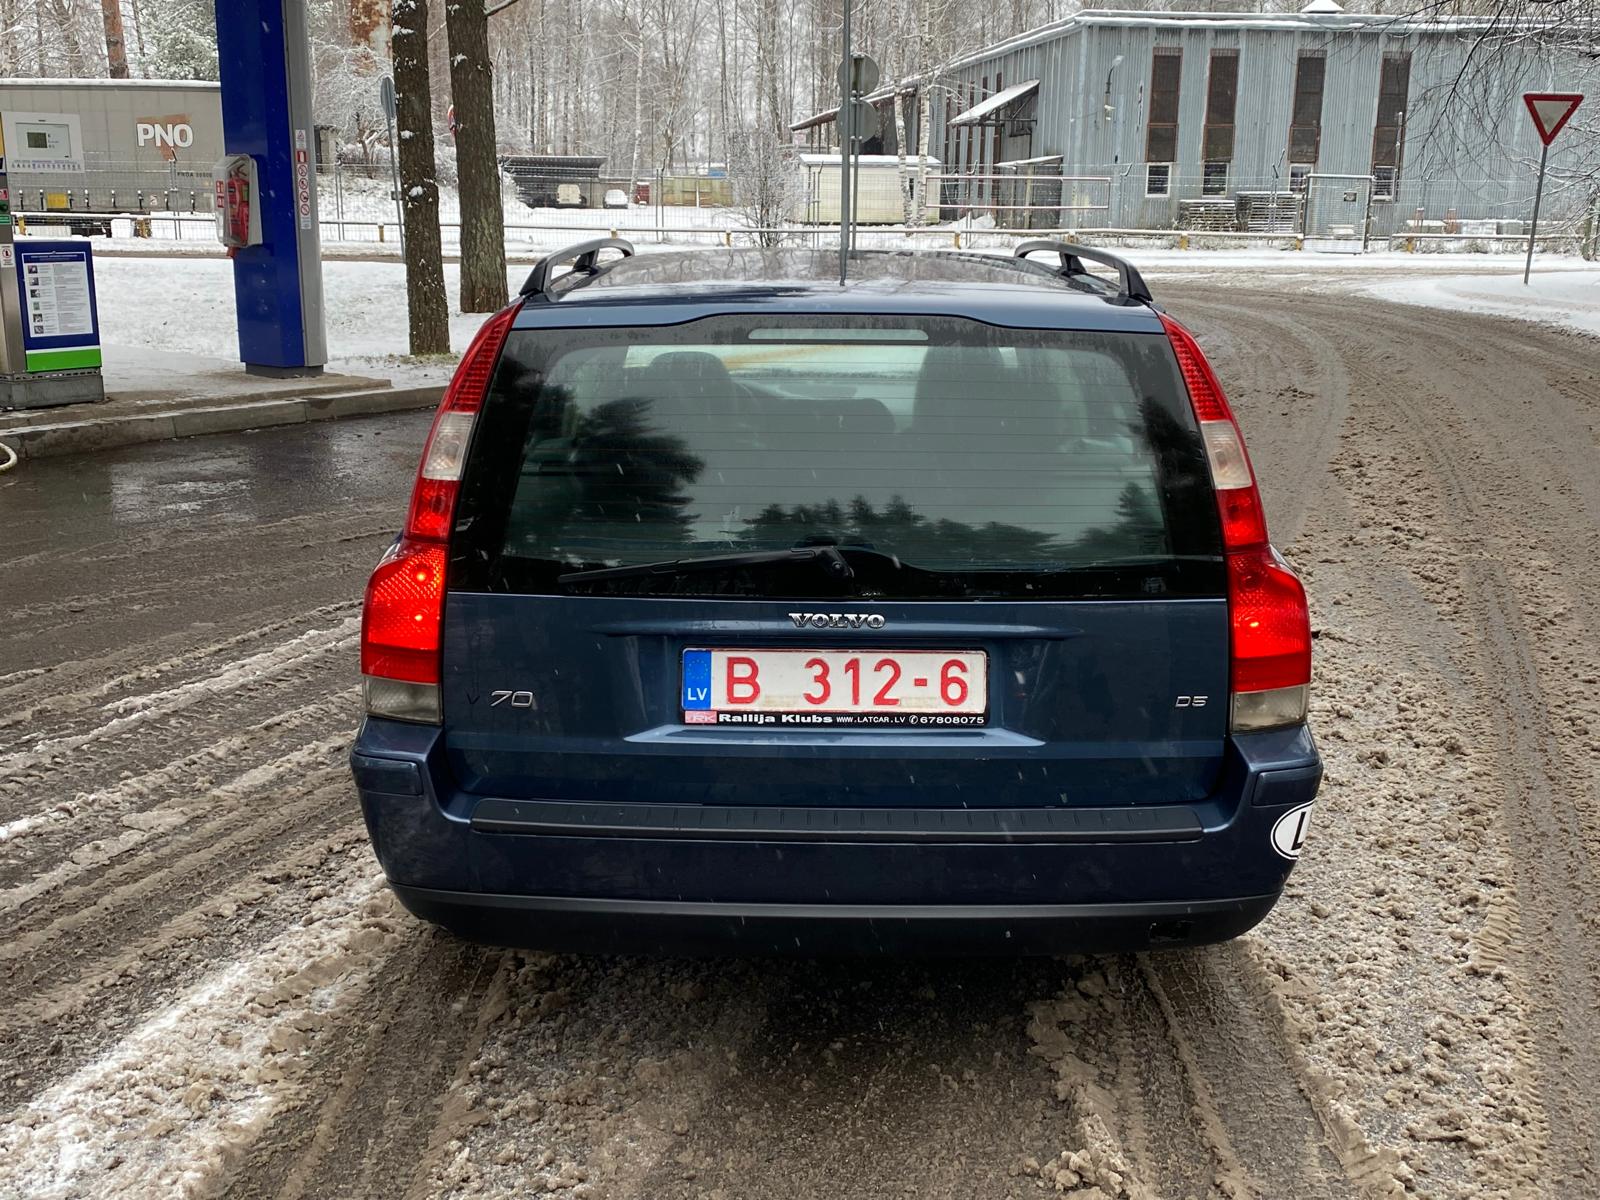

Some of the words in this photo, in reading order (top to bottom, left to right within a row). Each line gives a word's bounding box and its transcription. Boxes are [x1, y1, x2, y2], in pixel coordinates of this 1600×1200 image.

[137, 123, 193, 148] PNO
[788, 613, 886, 629] VOLVO
[726, 656, 761, 705] B
[802, 657, 970, 706] 312-6
[490, 690, 534, 707] 70
[687, 687, 708, 701] LV
[1175, 695, 1209, 707] D5
[718, 713, 776, 724] Rallija
[781, 713, 833, 723] Klubs
[919, 716, 985, 724] 67808075
